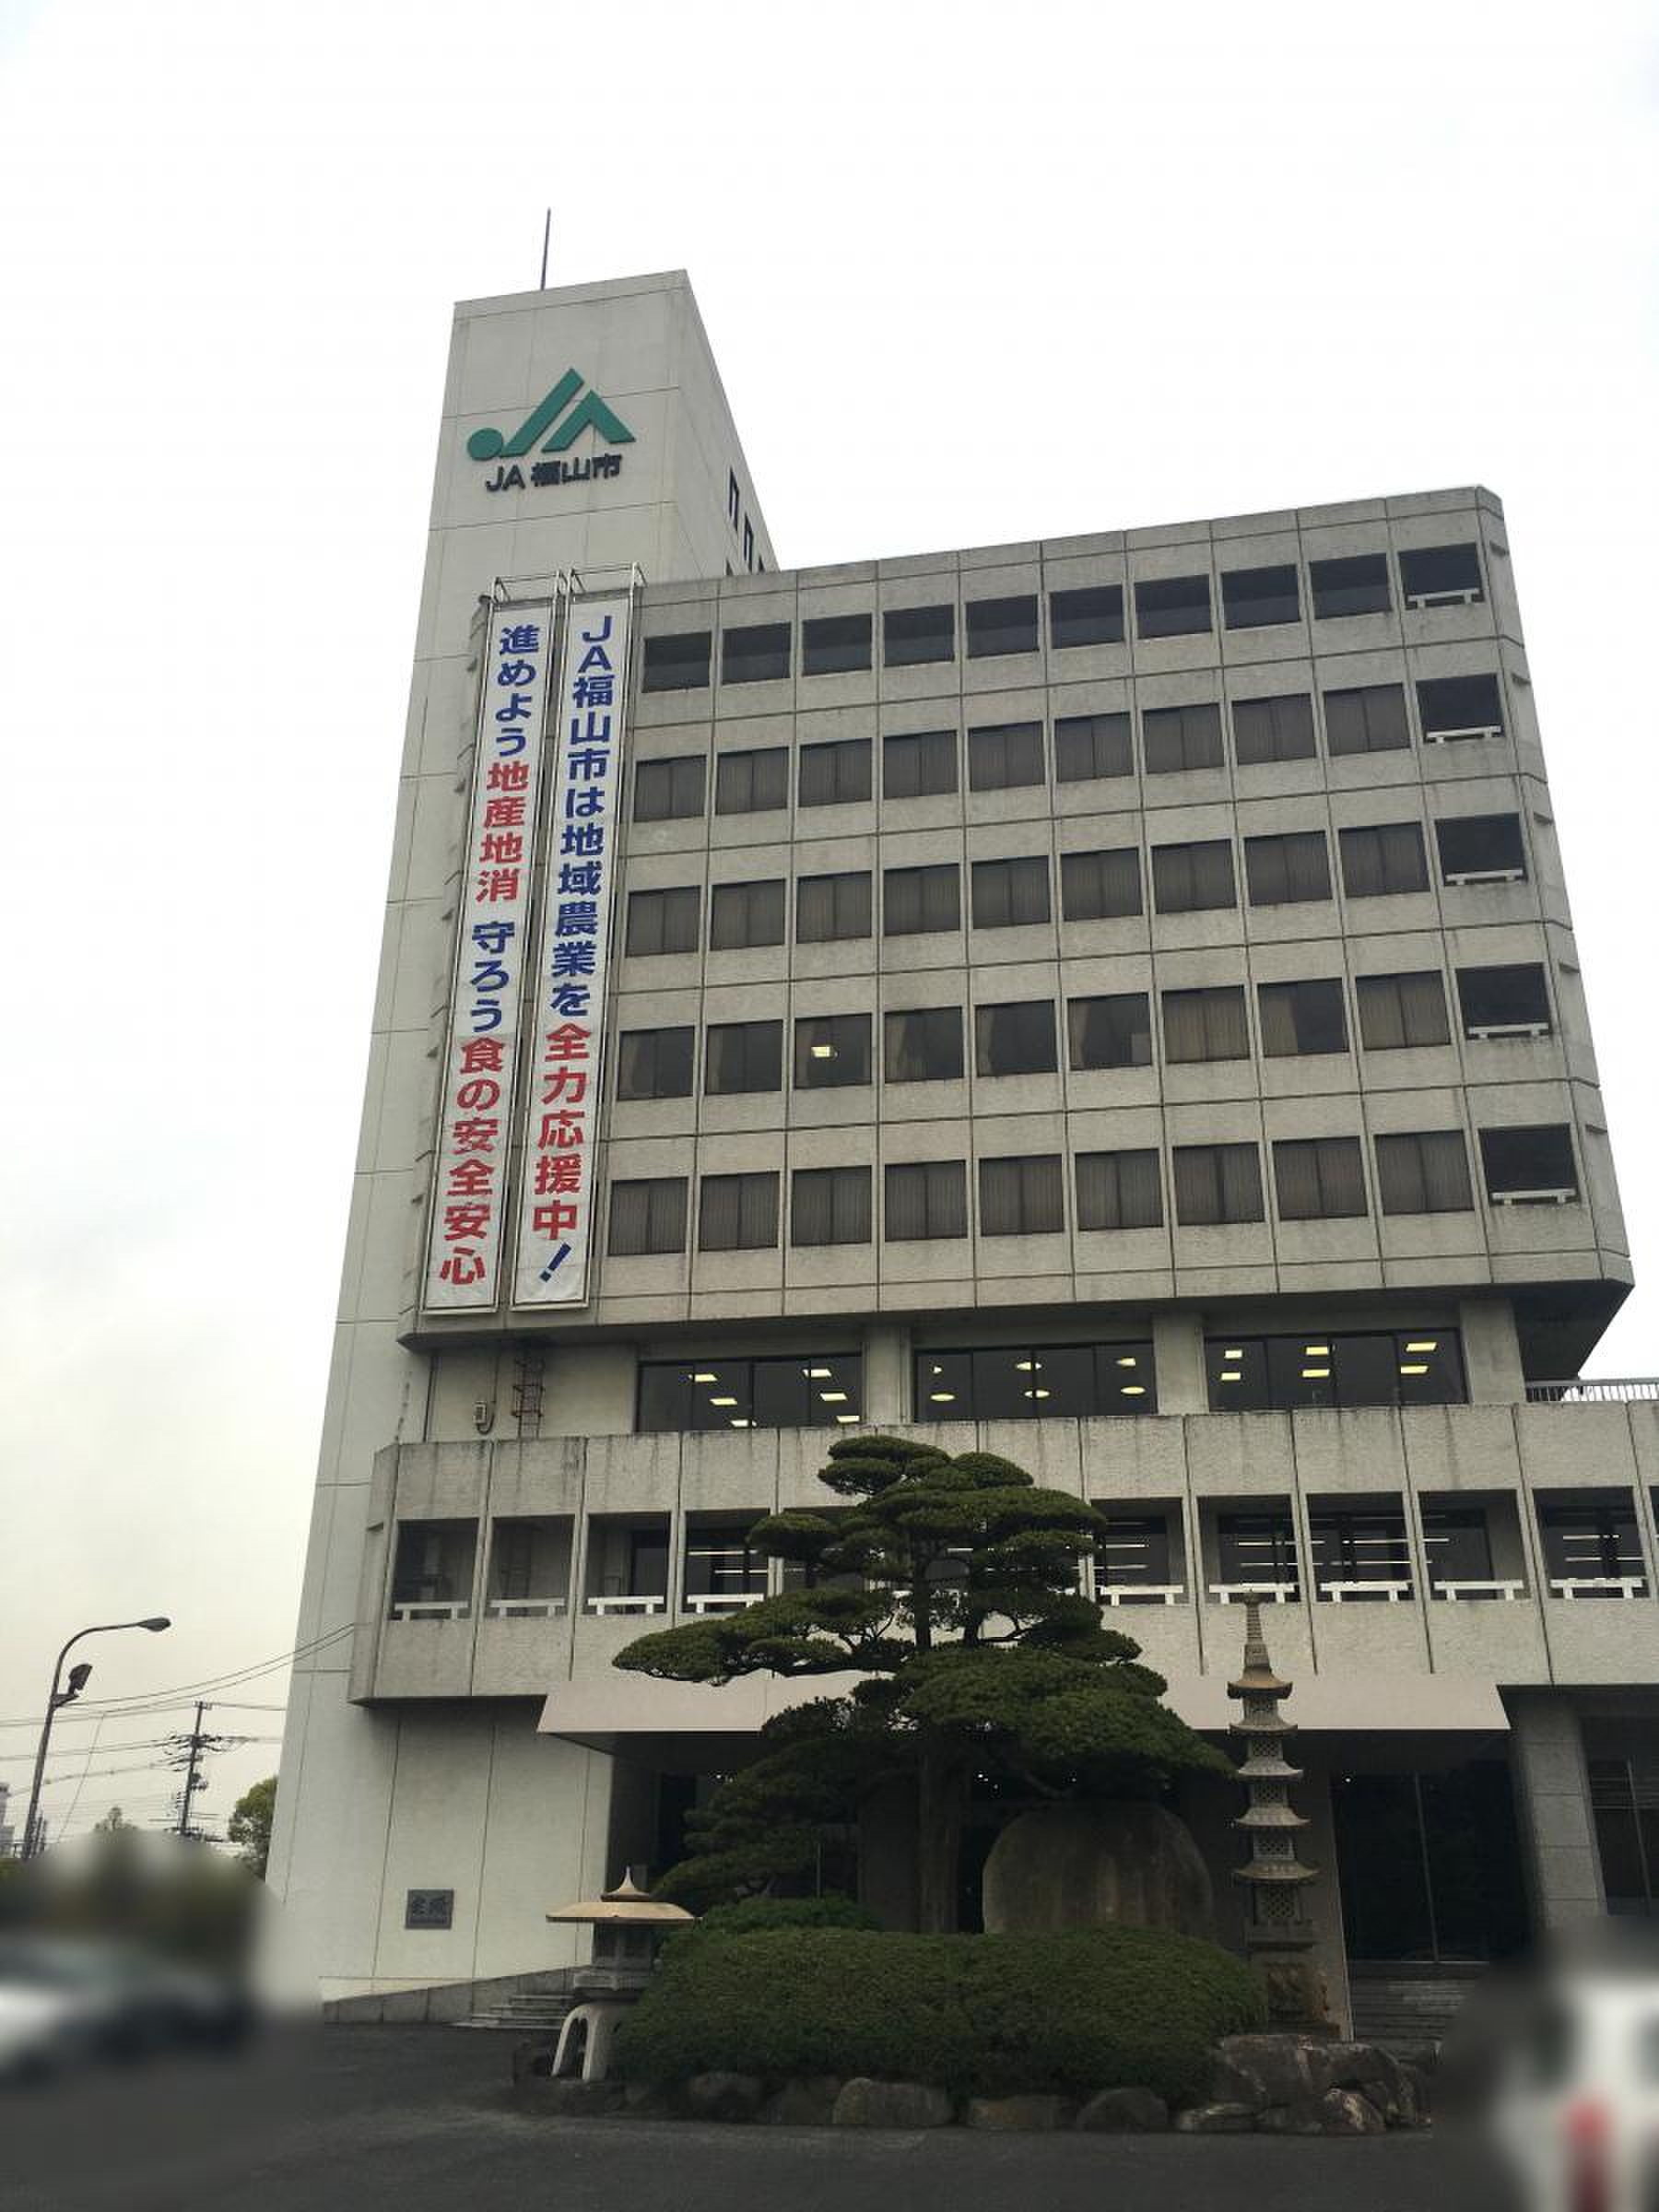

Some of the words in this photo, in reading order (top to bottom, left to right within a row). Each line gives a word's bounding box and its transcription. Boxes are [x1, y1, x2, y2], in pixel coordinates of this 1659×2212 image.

[485, 464, 526, 492] JA
[531, 453, 622, 488] 福山市
[477, 624, 540, 902] 進めよう地産地消
[441, 922, 515, 1285] 守ろう食の安全安心
